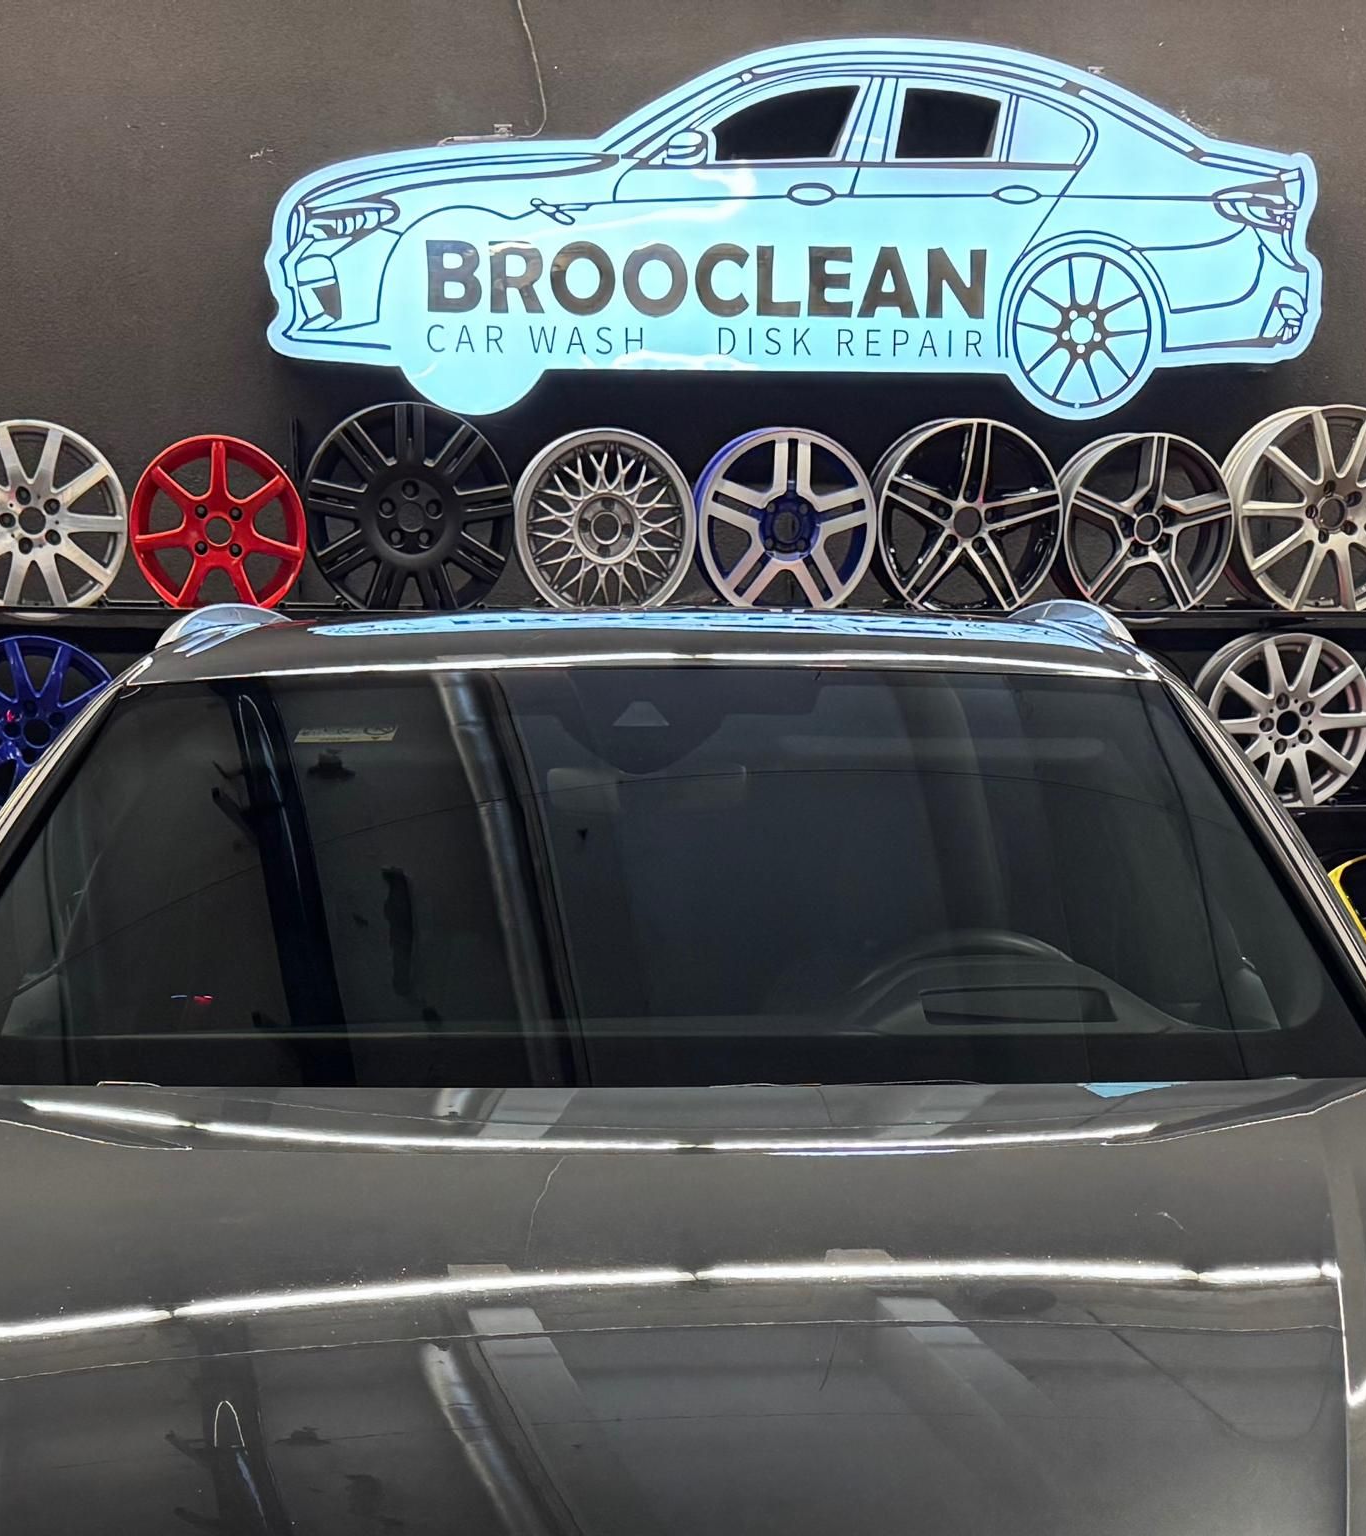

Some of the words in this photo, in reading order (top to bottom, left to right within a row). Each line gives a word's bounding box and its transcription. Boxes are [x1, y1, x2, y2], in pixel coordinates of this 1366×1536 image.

[424, 240, 988, 321] BROOCLEAN
[428, 324, 504, 356] CAR
[528, 325, 646, 357] WASH
[717, 328, 813, 357] DISK
[835, 329, 983, 358] REPAIR
